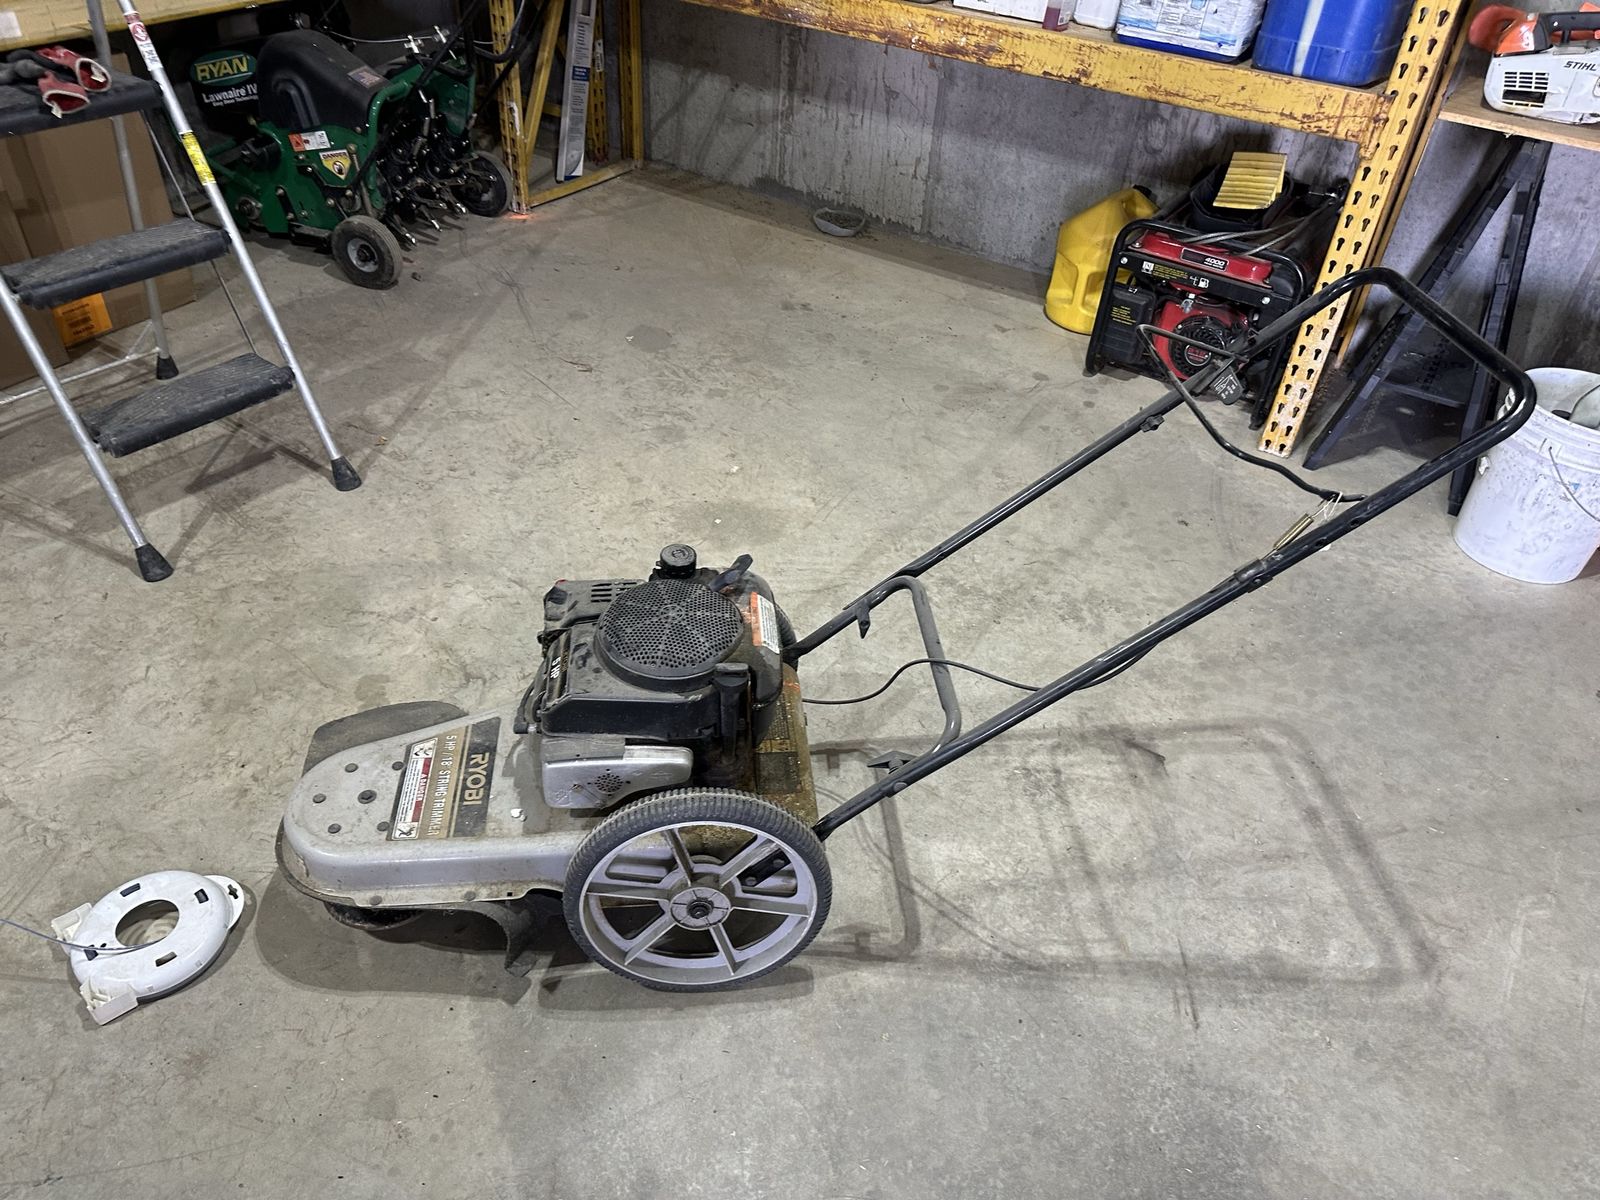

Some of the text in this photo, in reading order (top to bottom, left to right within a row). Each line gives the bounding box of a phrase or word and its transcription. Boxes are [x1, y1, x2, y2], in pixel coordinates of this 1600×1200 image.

[195, 56, 249, 81] RYAN
[1564, 60, 1597, 72] STIHL
[202, 86, 246, 103] Lawnaire
[246, 83, 258, 95] IV
[1204, 257, 1225, 267] 4000
[550, 656, 561, 679] 5 HP
[444, 741, 457, 751] HP
[416, 778, 427, 802] DANGER
[435, 770, 452, 797] STRING
[463, 752, 490, 806] RYOBI
[427, 799, 445, 836] TRIMMER
